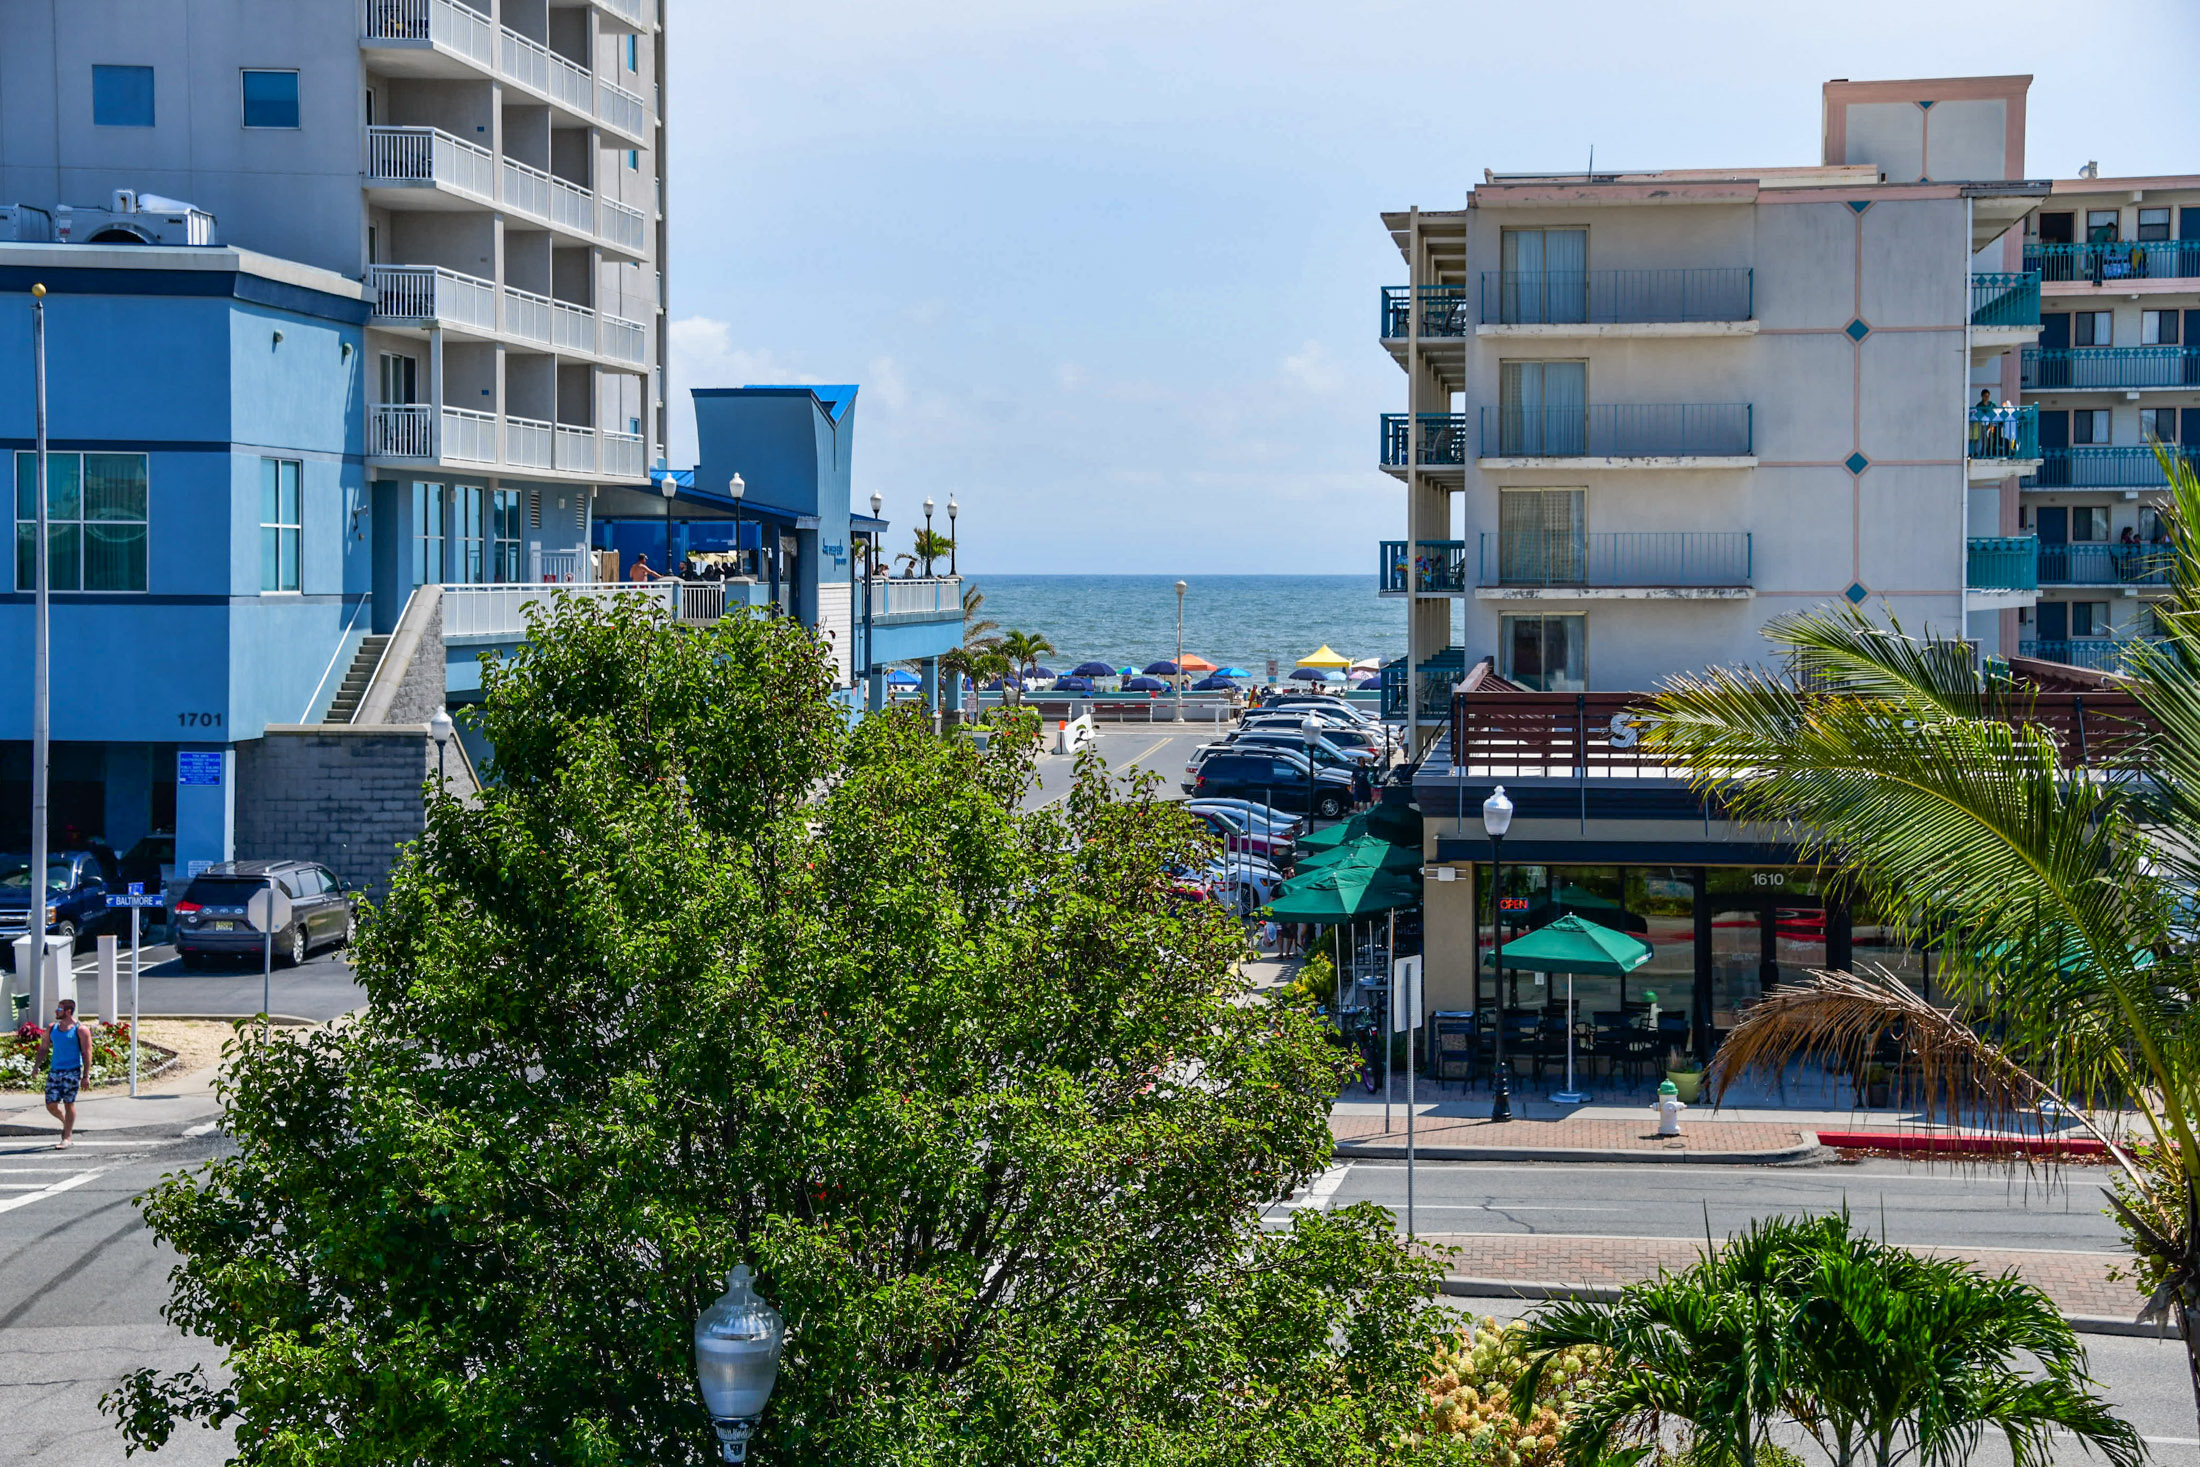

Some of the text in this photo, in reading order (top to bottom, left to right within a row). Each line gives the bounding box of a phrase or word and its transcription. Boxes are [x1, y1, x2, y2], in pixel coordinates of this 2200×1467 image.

[178, 712, 222, 727] 1701
[1751, 873, 1784, 886] 1610
[116, 896, 153, 905] BALTIMORE
[1500, 899, 1528, 909] OPEN
